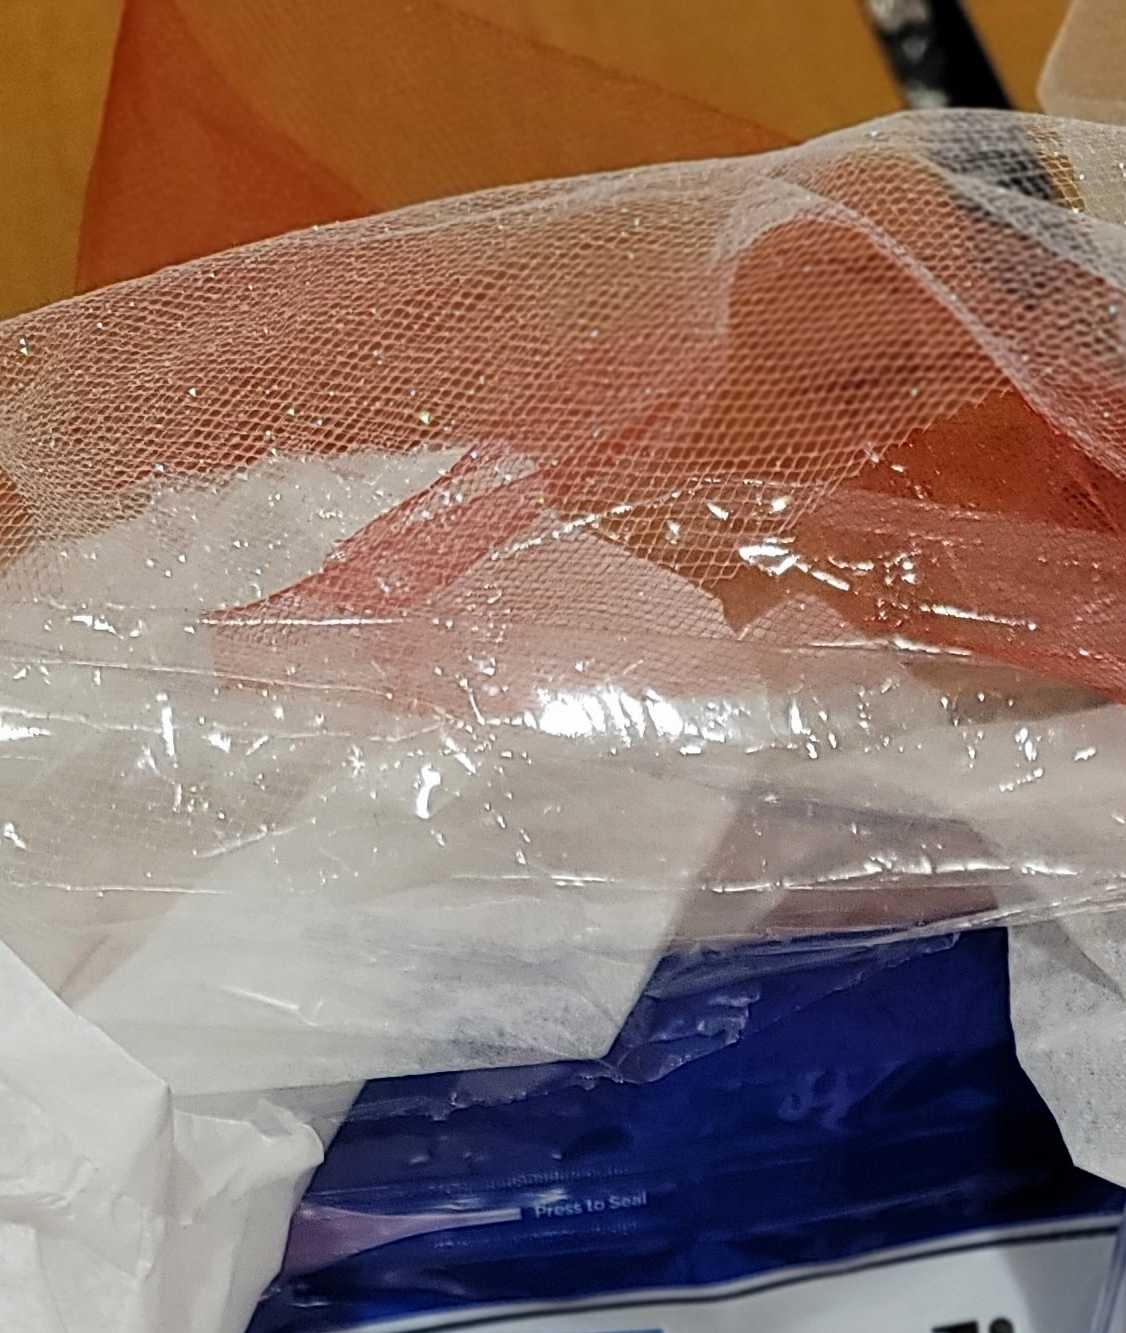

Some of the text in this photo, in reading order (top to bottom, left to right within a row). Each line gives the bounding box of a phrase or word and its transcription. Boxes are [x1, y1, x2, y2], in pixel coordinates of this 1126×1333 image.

[535, 1192, 648, 1220] Press to Seal
